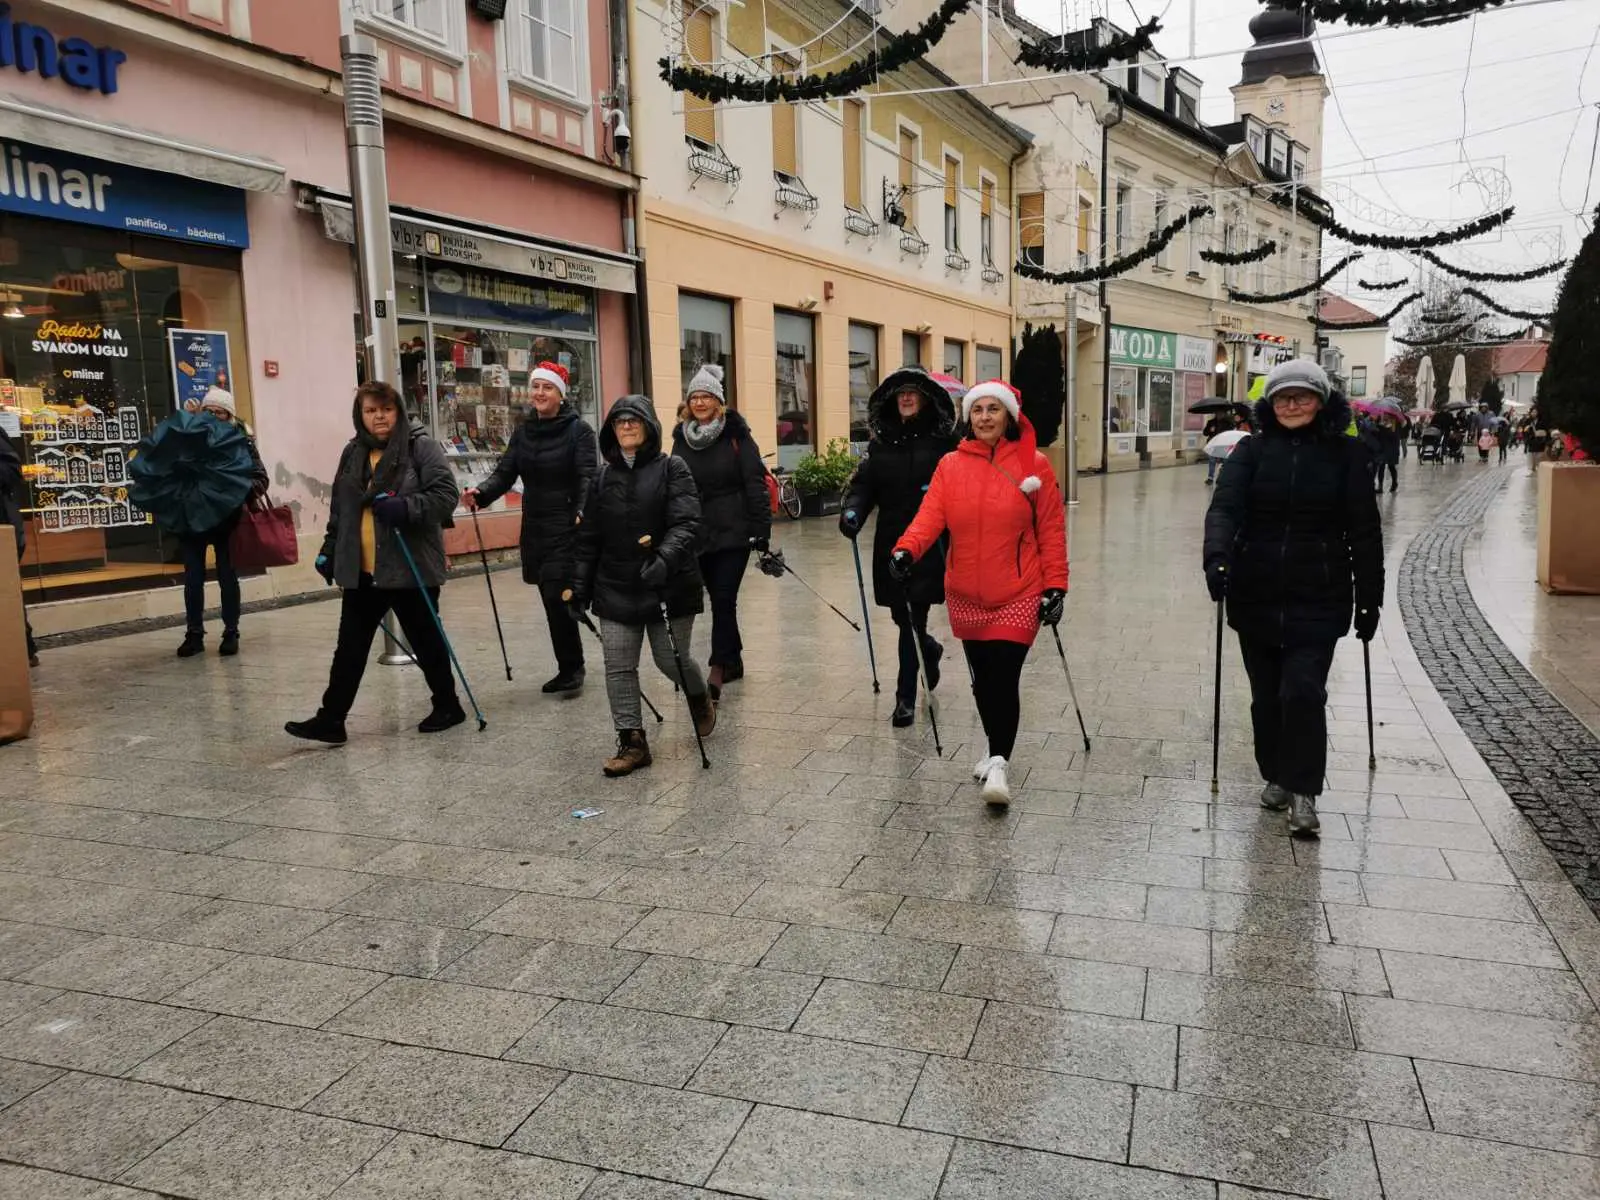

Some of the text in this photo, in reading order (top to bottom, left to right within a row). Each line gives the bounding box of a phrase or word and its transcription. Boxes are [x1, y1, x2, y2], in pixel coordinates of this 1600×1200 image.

[444, 246, 482, 261] BOOKSHOP
[37, 320, 122, 341] Radost NA
[32, 341, 128, 357] SVAKOM UGLU
[1110, 328, 1170, 359] MODA
[72, 368, 104, 380] mlinar
